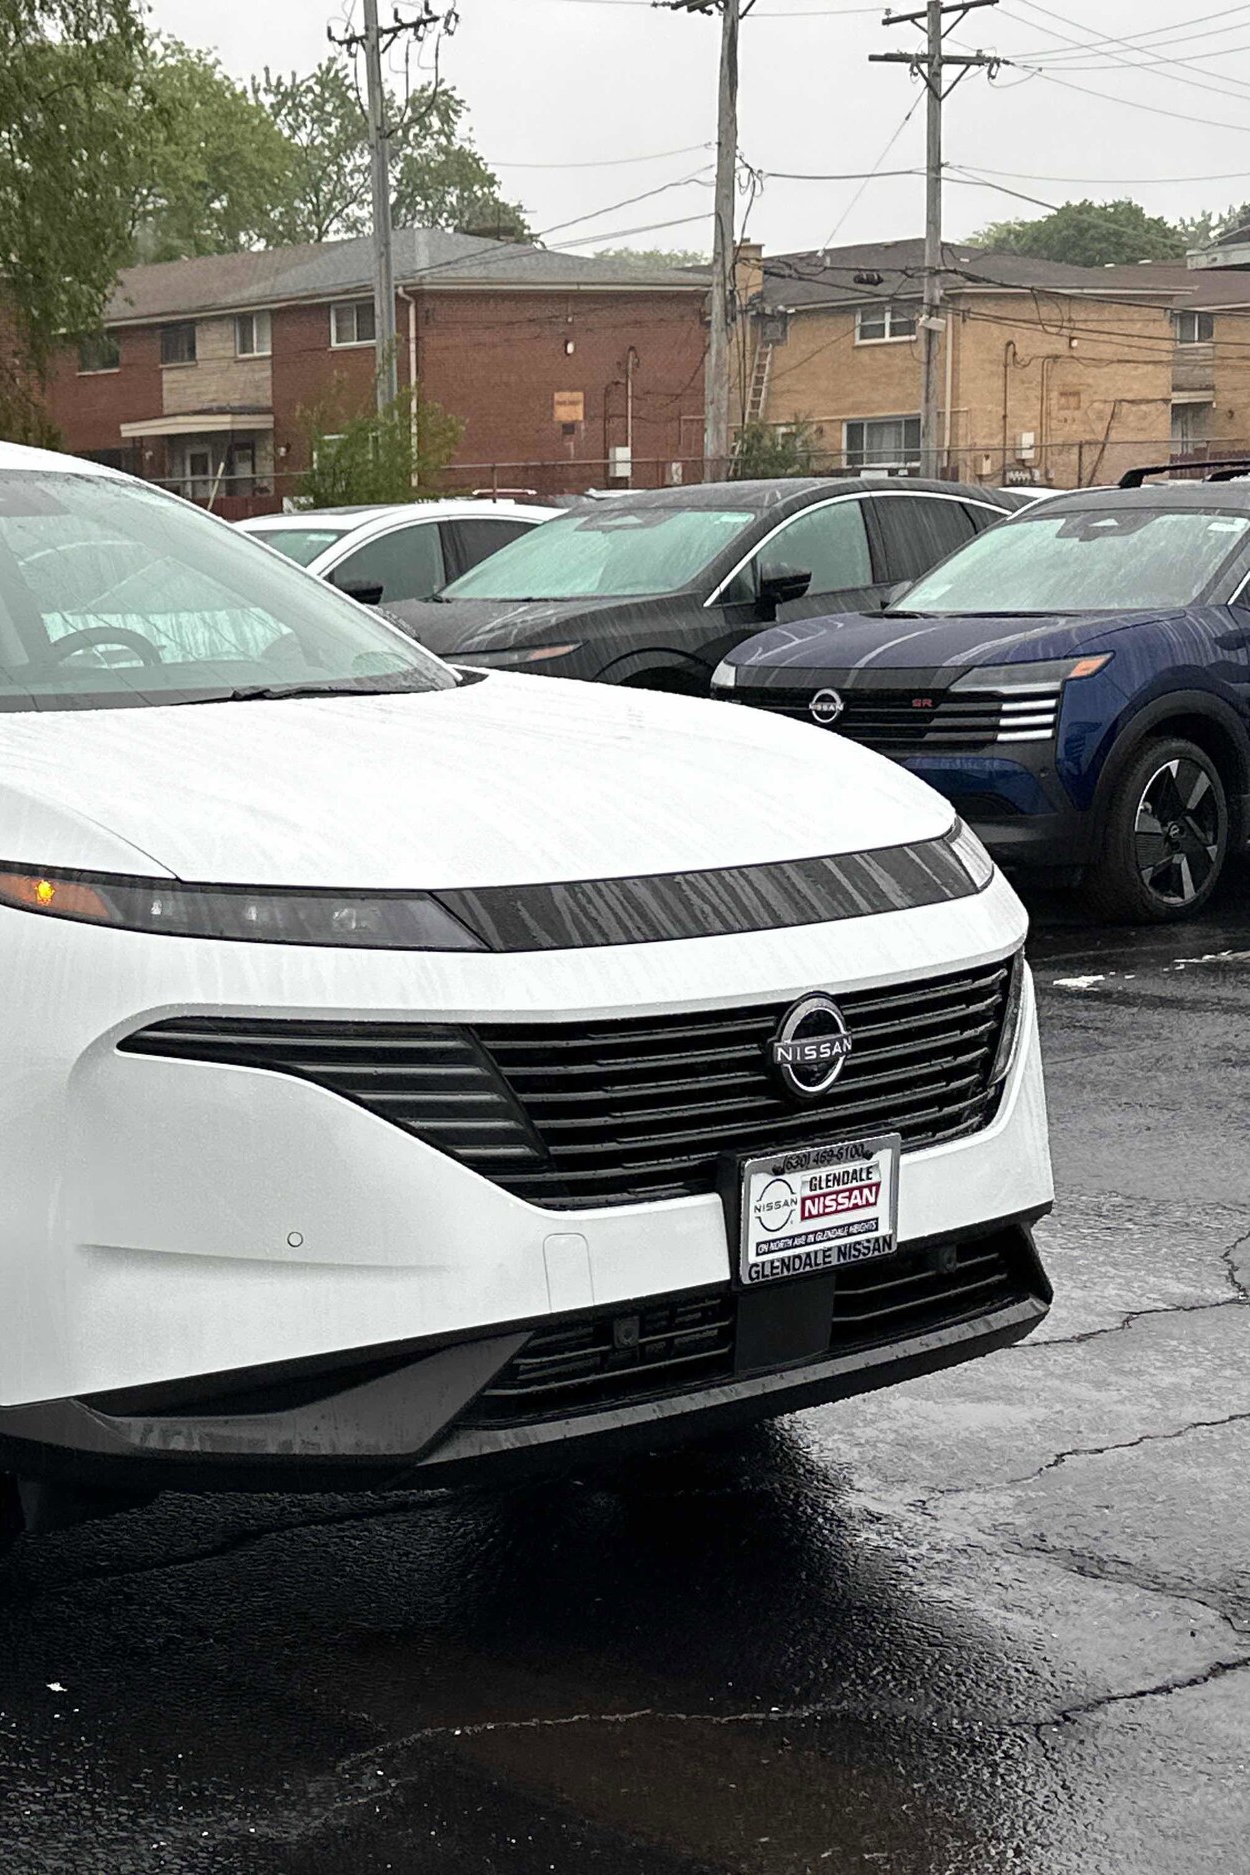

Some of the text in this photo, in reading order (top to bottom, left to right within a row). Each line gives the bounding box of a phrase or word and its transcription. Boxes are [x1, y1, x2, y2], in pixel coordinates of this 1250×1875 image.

[912, 698, 932, 707] SR
[777, 1036, 851, 1061] NISSAN
[809, 1165, 873, 1192] GLENDALE
[754, 1197, 798, 1214] NISSAN
[804, 1186, 877, 1217] NISSAN
[815, 1226, 848, 1241] GLENDALE
[849, 1219, 877, 1234] HEIGHTS
[748, 1235, 892, 1283] GLENDALE NISSAN
